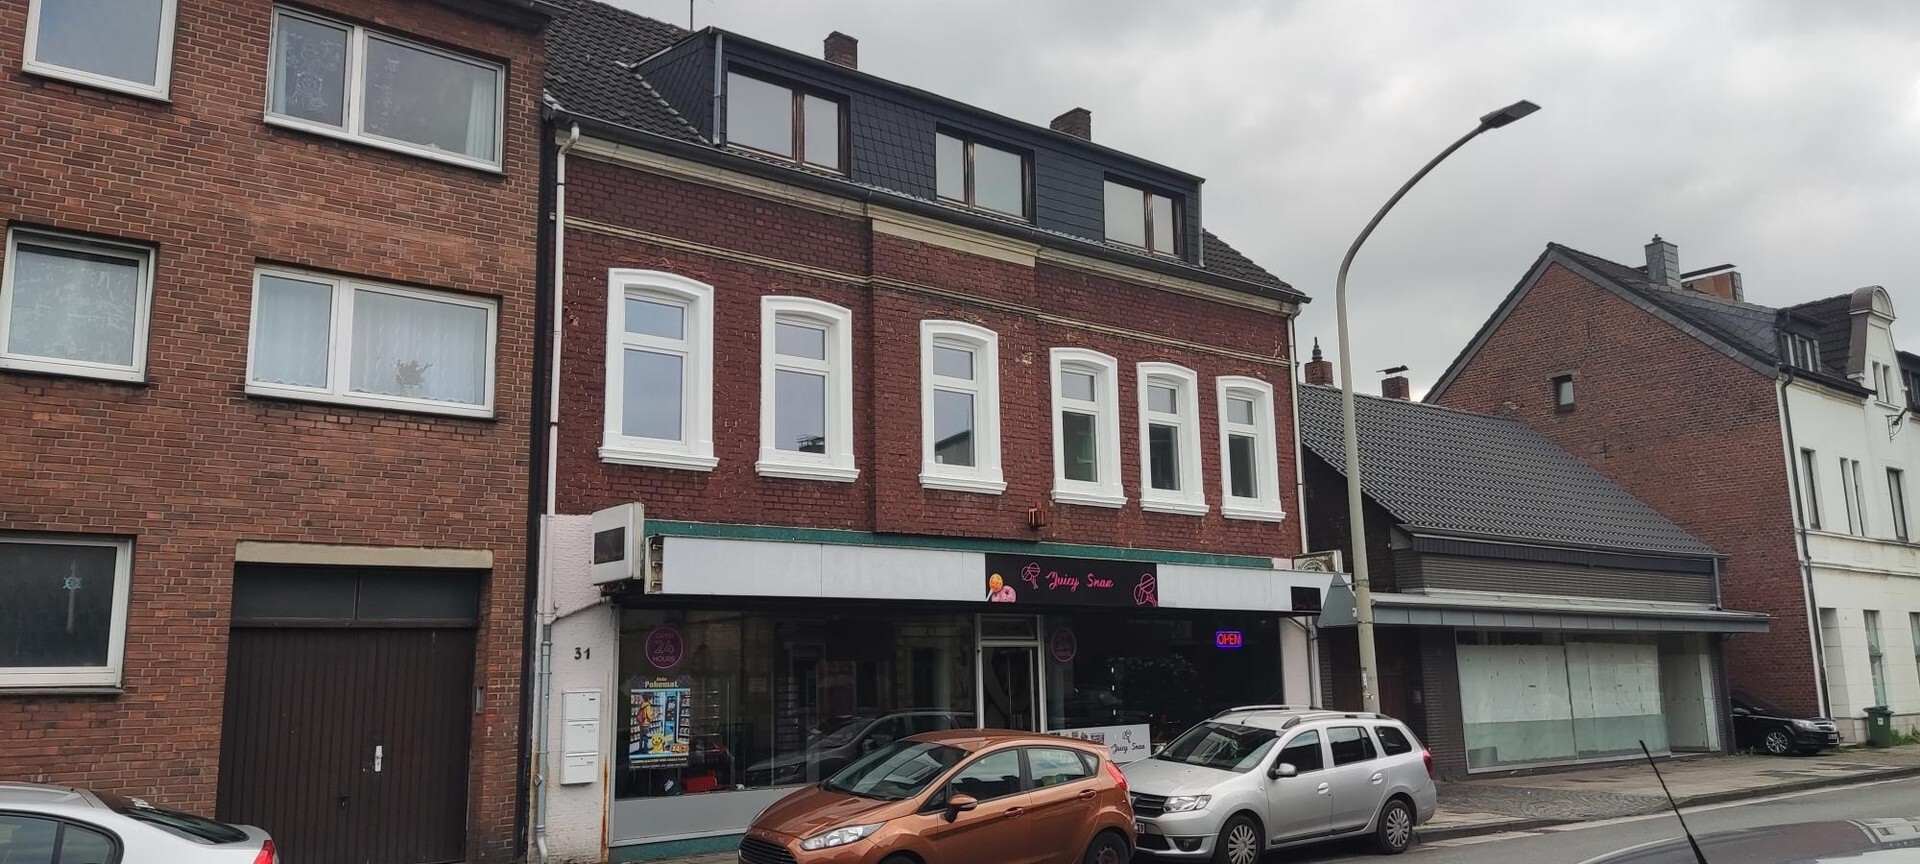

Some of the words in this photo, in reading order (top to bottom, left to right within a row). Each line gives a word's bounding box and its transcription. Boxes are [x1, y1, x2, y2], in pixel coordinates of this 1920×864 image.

[1045, 570, 1080, 592] Juicy
[1087, 572, 1114, 588] Snax
[1218, 633, 1240, 645] OPEN
[574, 646, 590, 660] 31
[653, 639, 675, 654] 24
[1110, 743, 1128, 754] Juicy
[1131, 742, 1145, 751] Snax
